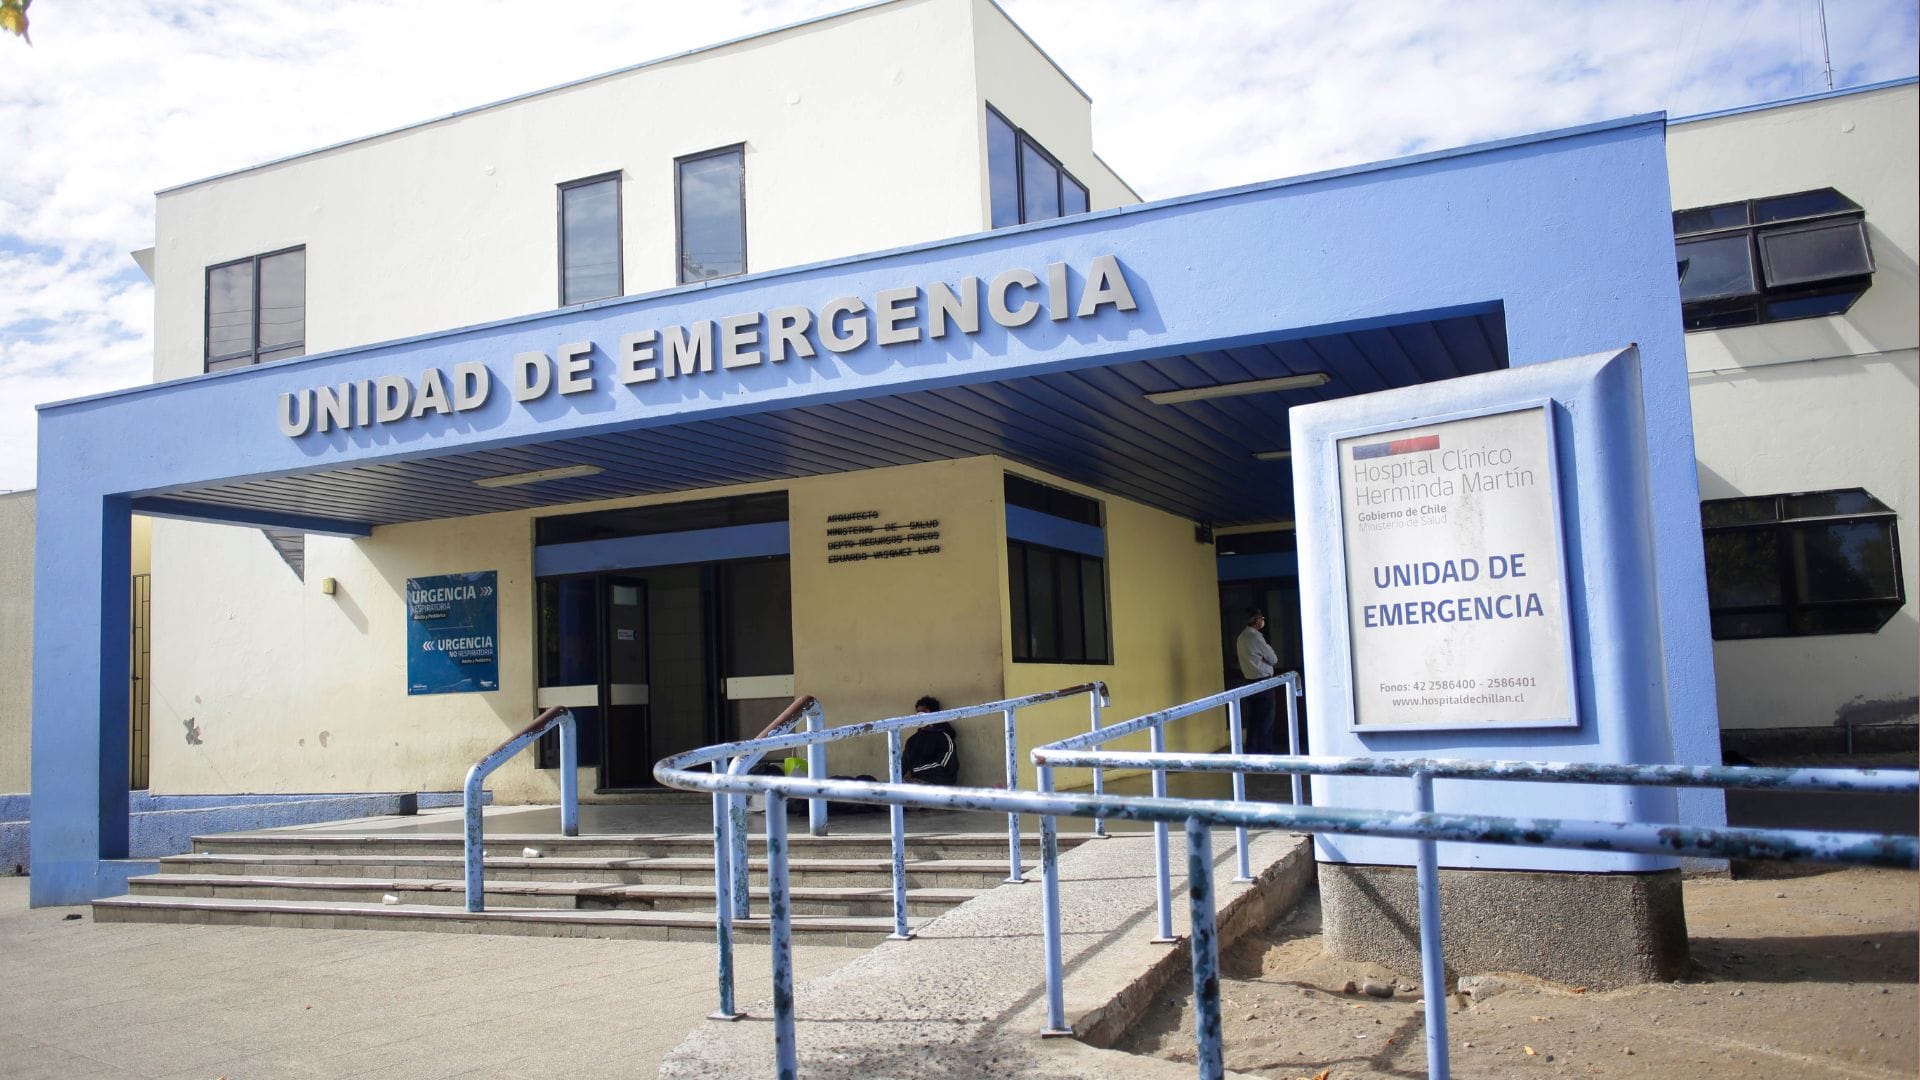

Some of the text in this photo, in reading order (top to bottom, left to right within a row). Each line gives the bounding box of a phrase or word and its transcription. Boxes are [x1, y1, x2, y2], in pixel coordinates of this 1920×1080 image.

[278, 254, 1137, 437] UNIDAD DE EMERGENCIA
[1354, 446, 1512, 483] Hospital Clínico
[1356, 466, 1534, 506] Herminda Martín
[827, 511, 879, 523] ARQUITECTO
[1358, 503, 1447, 522] Gobierno de Chile
[827, 520, 939, 536] MINISTERIO DE SALUD
[1358, 514, 1447, 533] Ministerio de Salud
[828, 540, 854, 550] DEPTO
[859, 535, 902, 547] RECURSOS
[828, 552, 868, 564] EDUARDO
[1373, 553, 1527, 589] UNIDAD DE
[412, 586, 476, 604] URGENCIA
[412, 602, 451, 613] RESPIRATORIA
[1363, 592, 1544, 628] EMERGENCIA
[438, 635, 493, 651] URGENCIA
[458, 649, 493, 657] RESPIRATORIA
[1379, 681, 1411, 693] Fonos:
[1413, 681, 1426, 691] 42
[1429, 679, 1476, 691] 2586400
[1487, 677, 1537, 689] 2586401
[1392, 694, 1525, 707] www.hospitaldechillan.cl
